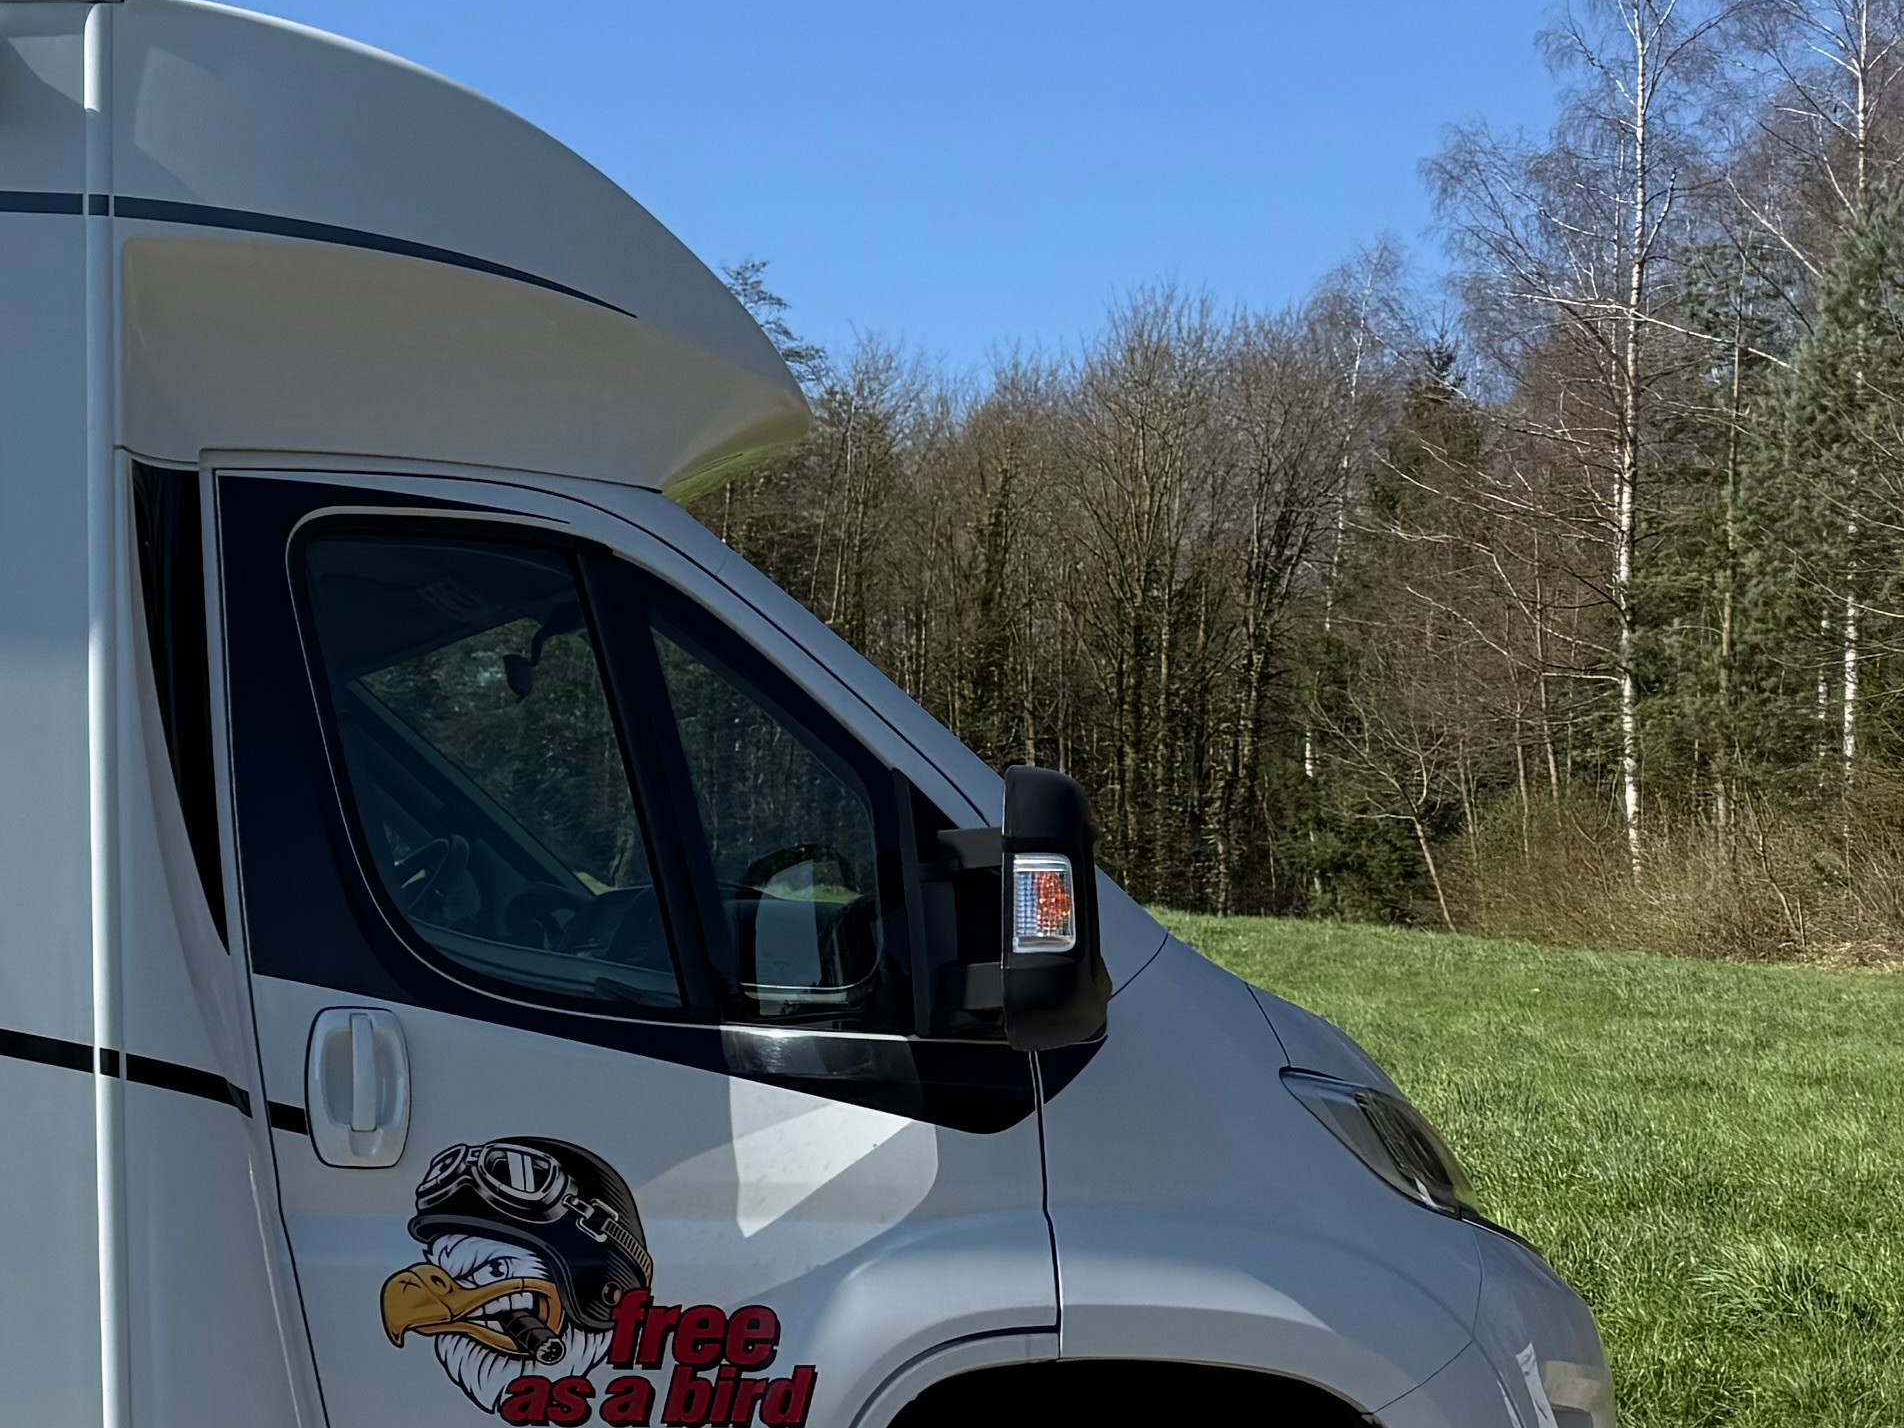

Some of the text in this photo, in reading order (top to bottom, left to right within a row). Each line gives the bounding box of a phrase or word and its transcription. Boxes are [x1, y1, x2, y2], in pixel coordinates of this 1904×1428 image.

[607, 1289, 781, 1372] free
[500, 1375, 597, 1428] as
[599, 1375, 656, 1428] a
